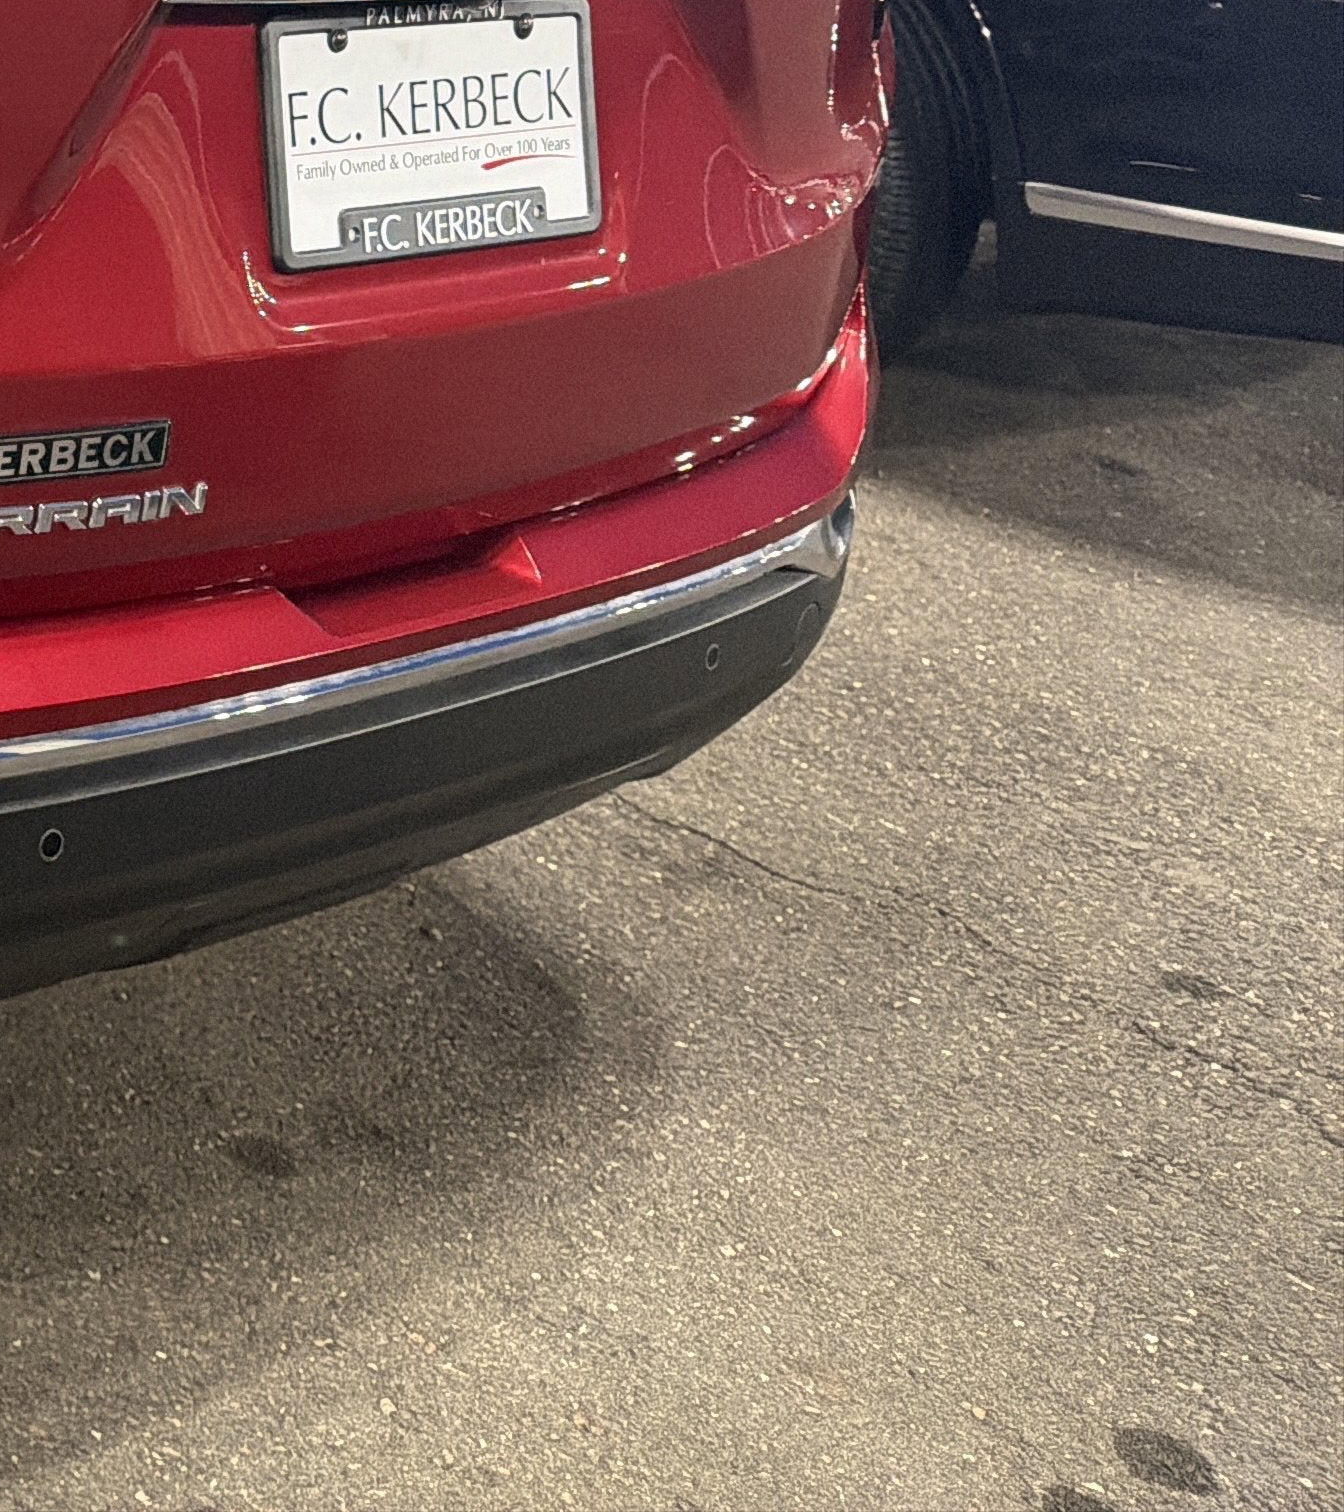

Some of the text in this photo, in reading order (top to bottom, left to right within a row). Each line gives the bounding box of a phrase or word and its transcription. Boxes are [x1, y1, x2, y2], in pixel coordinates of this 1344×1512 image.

[366, 3, 472, 26] PALMYRA,
[287, 67, 573, 147] F.C. KERBECK
[296, 137, 571, 181] Family Owned & Operated For Over 100 Years
[363, 199, 534, 253] F.C. KERBECK
